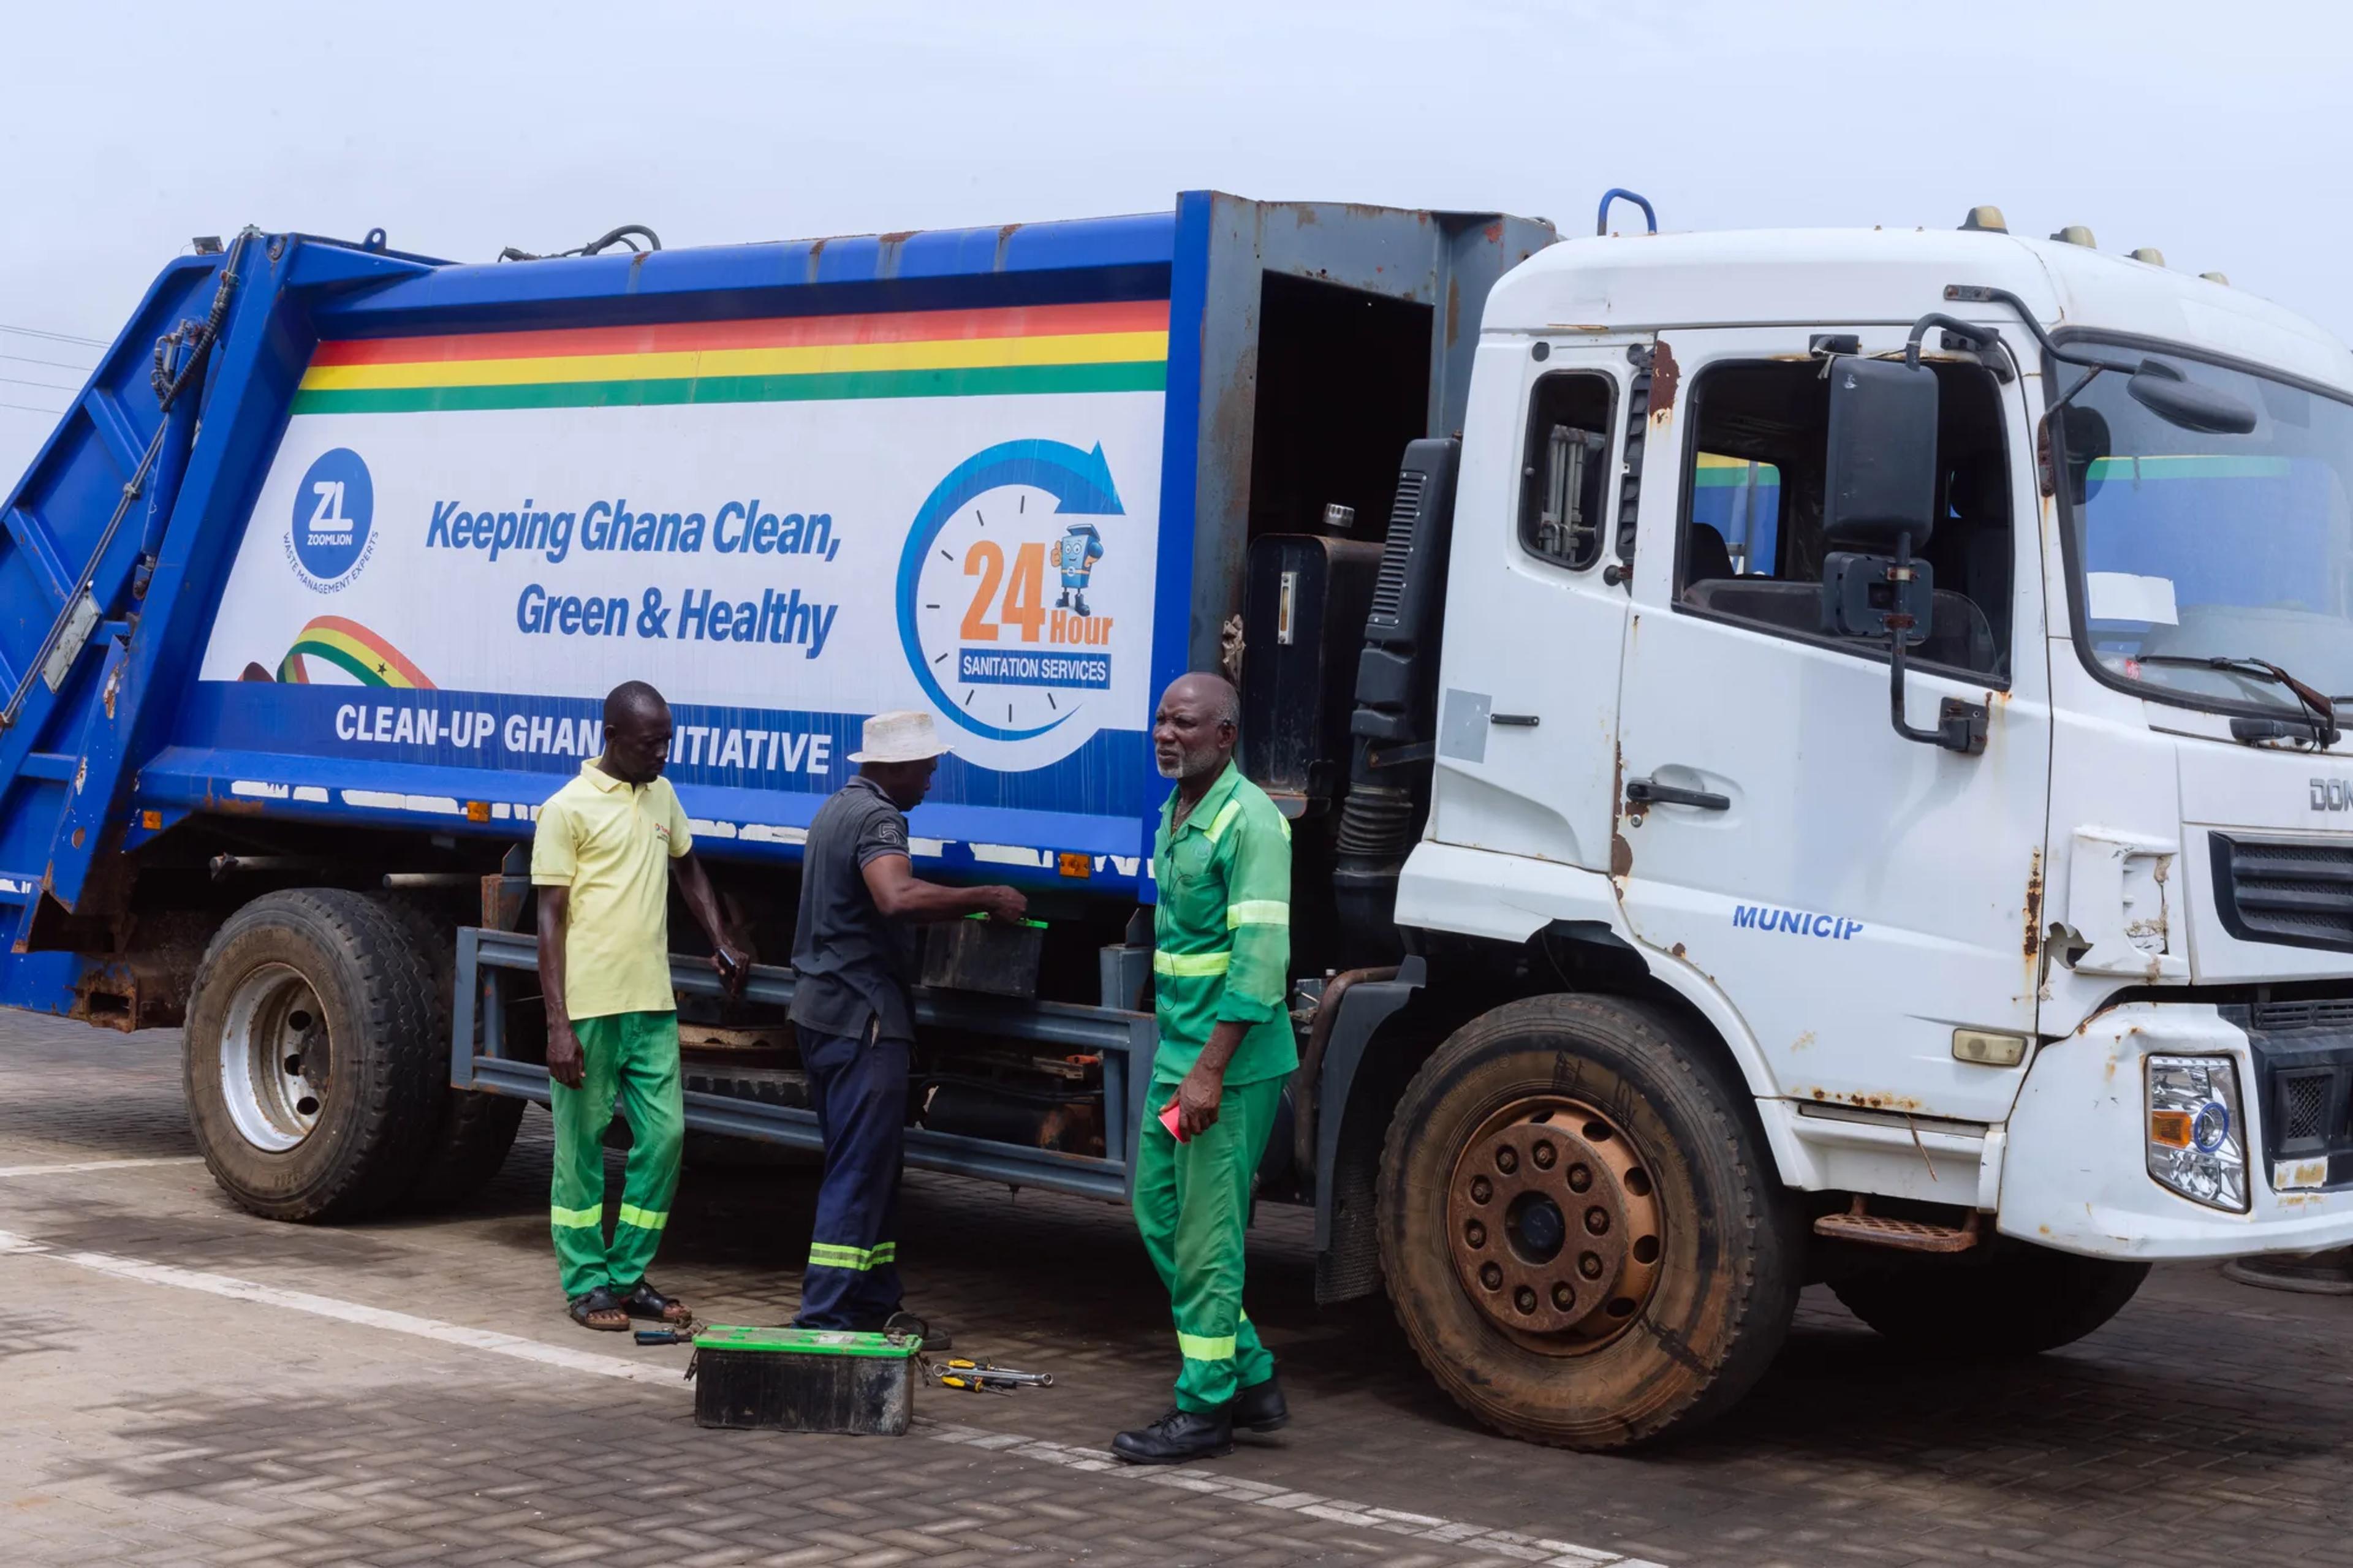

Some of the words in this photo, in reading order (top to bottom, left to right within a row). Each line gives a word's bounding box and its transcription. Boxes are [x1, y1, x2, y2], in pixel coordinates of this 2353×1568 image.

[309, 481, 354, 531] ZL
[426, 499, 576, 564] Keeping
[580, 499, 707, 553] Ghana
[712, 499, 840, 562] Clean,
[283, 531, 299, 571] WASTE
[297, 569, 351, 594] MANAGEMENT
[351, 531, 379, 580] EXPERTS
[307, 534, 352, 545] ZOOMLION
[517, 583, 629, 637] Green
[636, 586, 671, 639] &
[677, 588, 838, 659] Healthy
[960, 540, 1045, 643] 24
[1050, 610, 1113, 645] Hour
[963, 656, 1039, 678] SANITATION
[1041, 657, 1106, 681] SERVICES
[336, 704, 495, 748] CLEAN-UP
[504, 714, 607, 757] GHAN
[665, 725, 832, 775] ITIATIVE
[1733, 905, 1863, 940] MUNICIP
